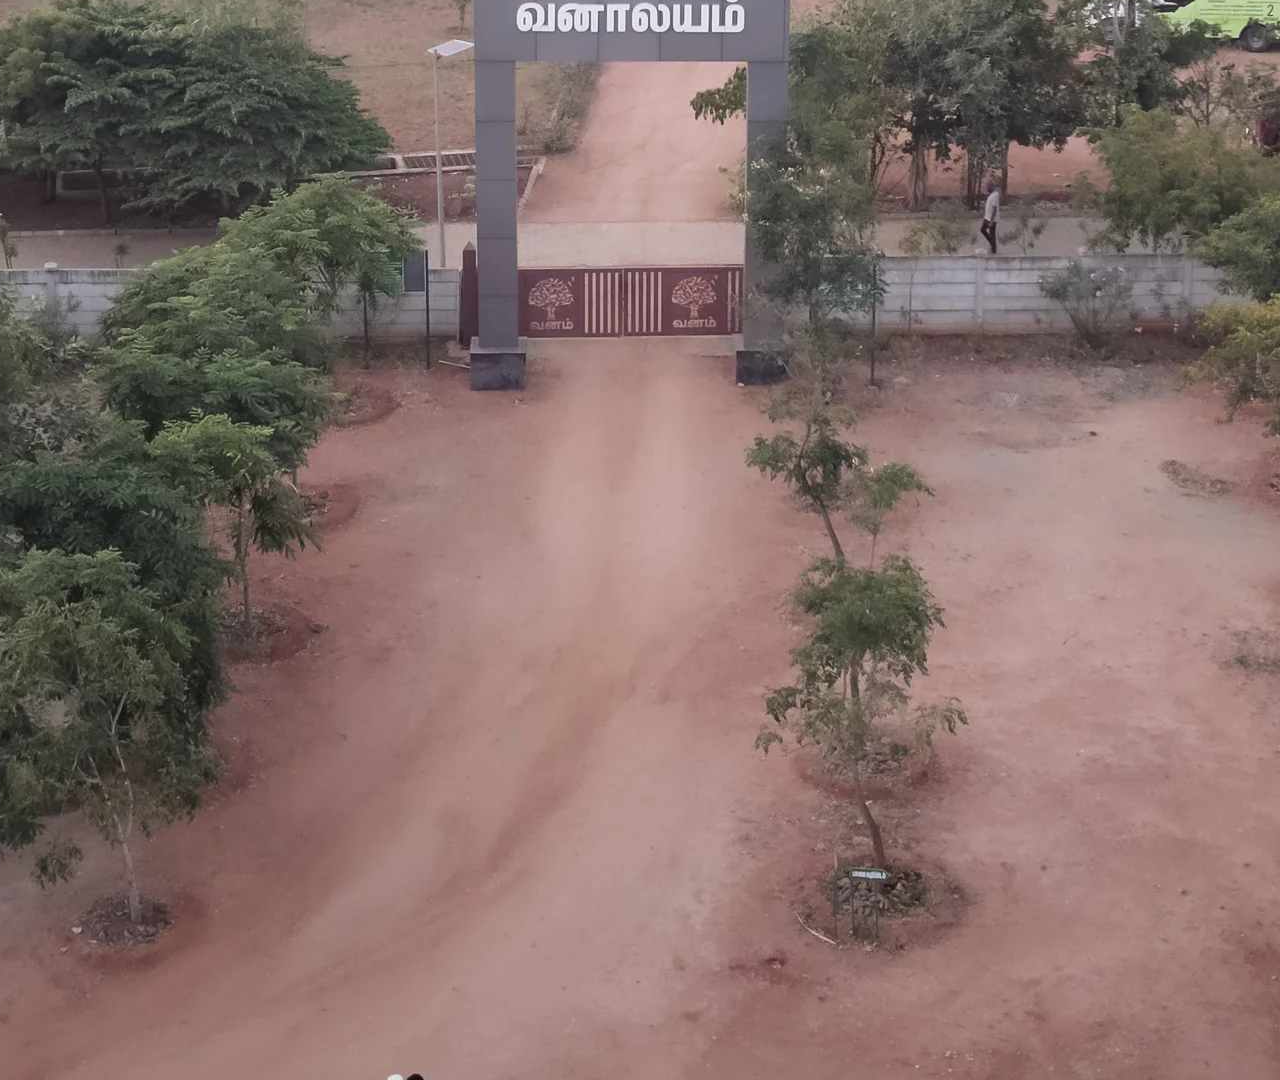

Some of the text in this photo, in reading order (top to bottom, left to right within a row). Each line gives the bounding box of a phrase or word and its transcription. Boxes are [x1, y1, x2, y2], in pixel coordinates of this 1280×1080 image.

[1267, 4, 1274, 16] 2
[530, 317, 574, 330] வனம்
[672, 315, 717, 328] வனம்
